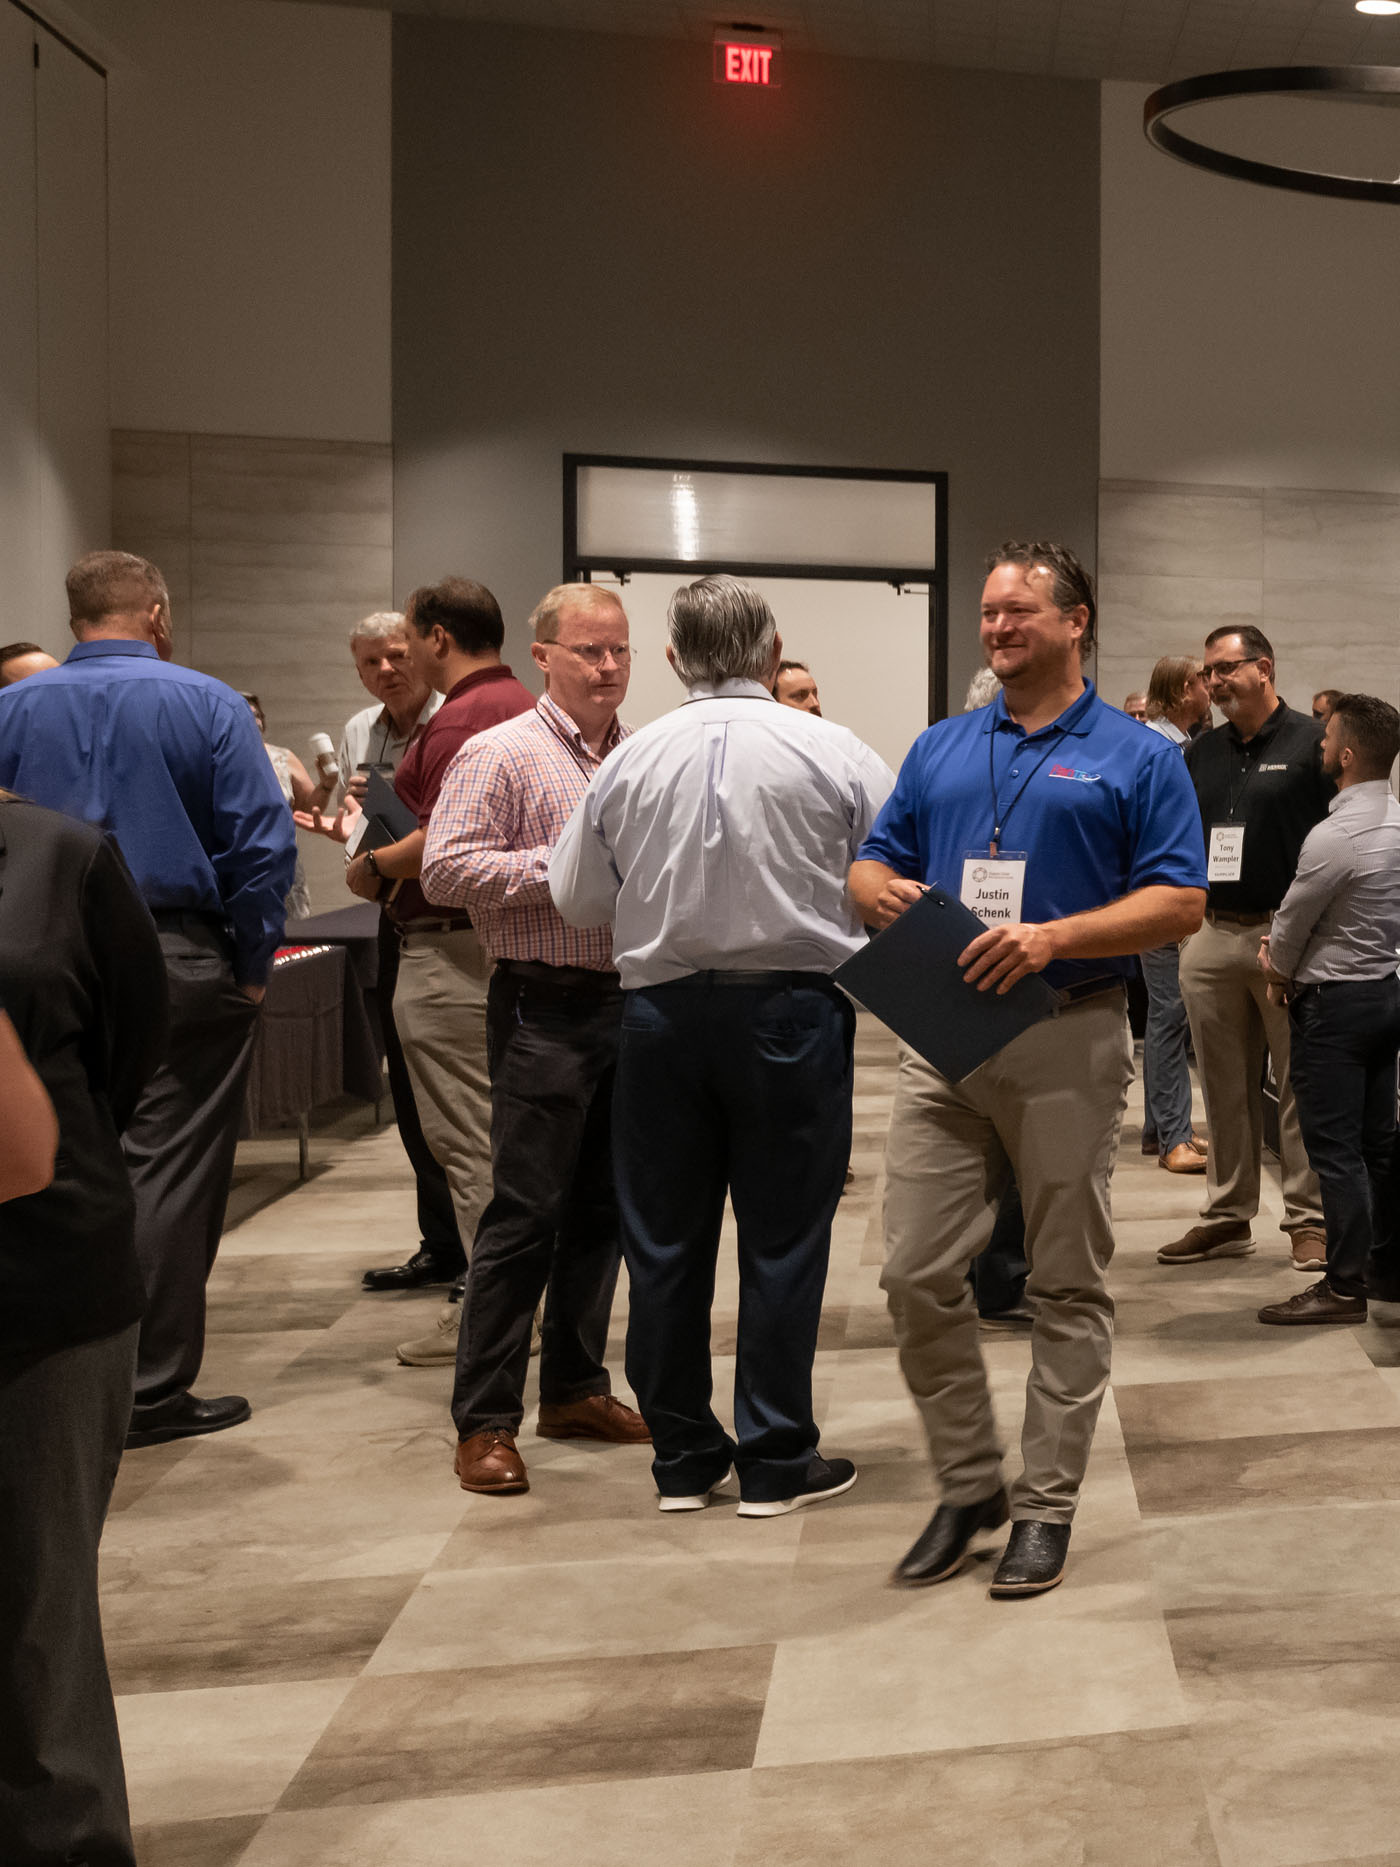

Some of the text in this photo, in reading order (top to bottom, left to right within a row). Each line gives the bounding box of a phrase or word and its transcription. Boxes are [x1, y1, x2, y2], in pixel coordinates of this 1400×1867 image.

[725, 46, 773, 85] EXIT
[975, 888, 1010, 900] Justin
[971, 906, 1011, 918] Schenk
